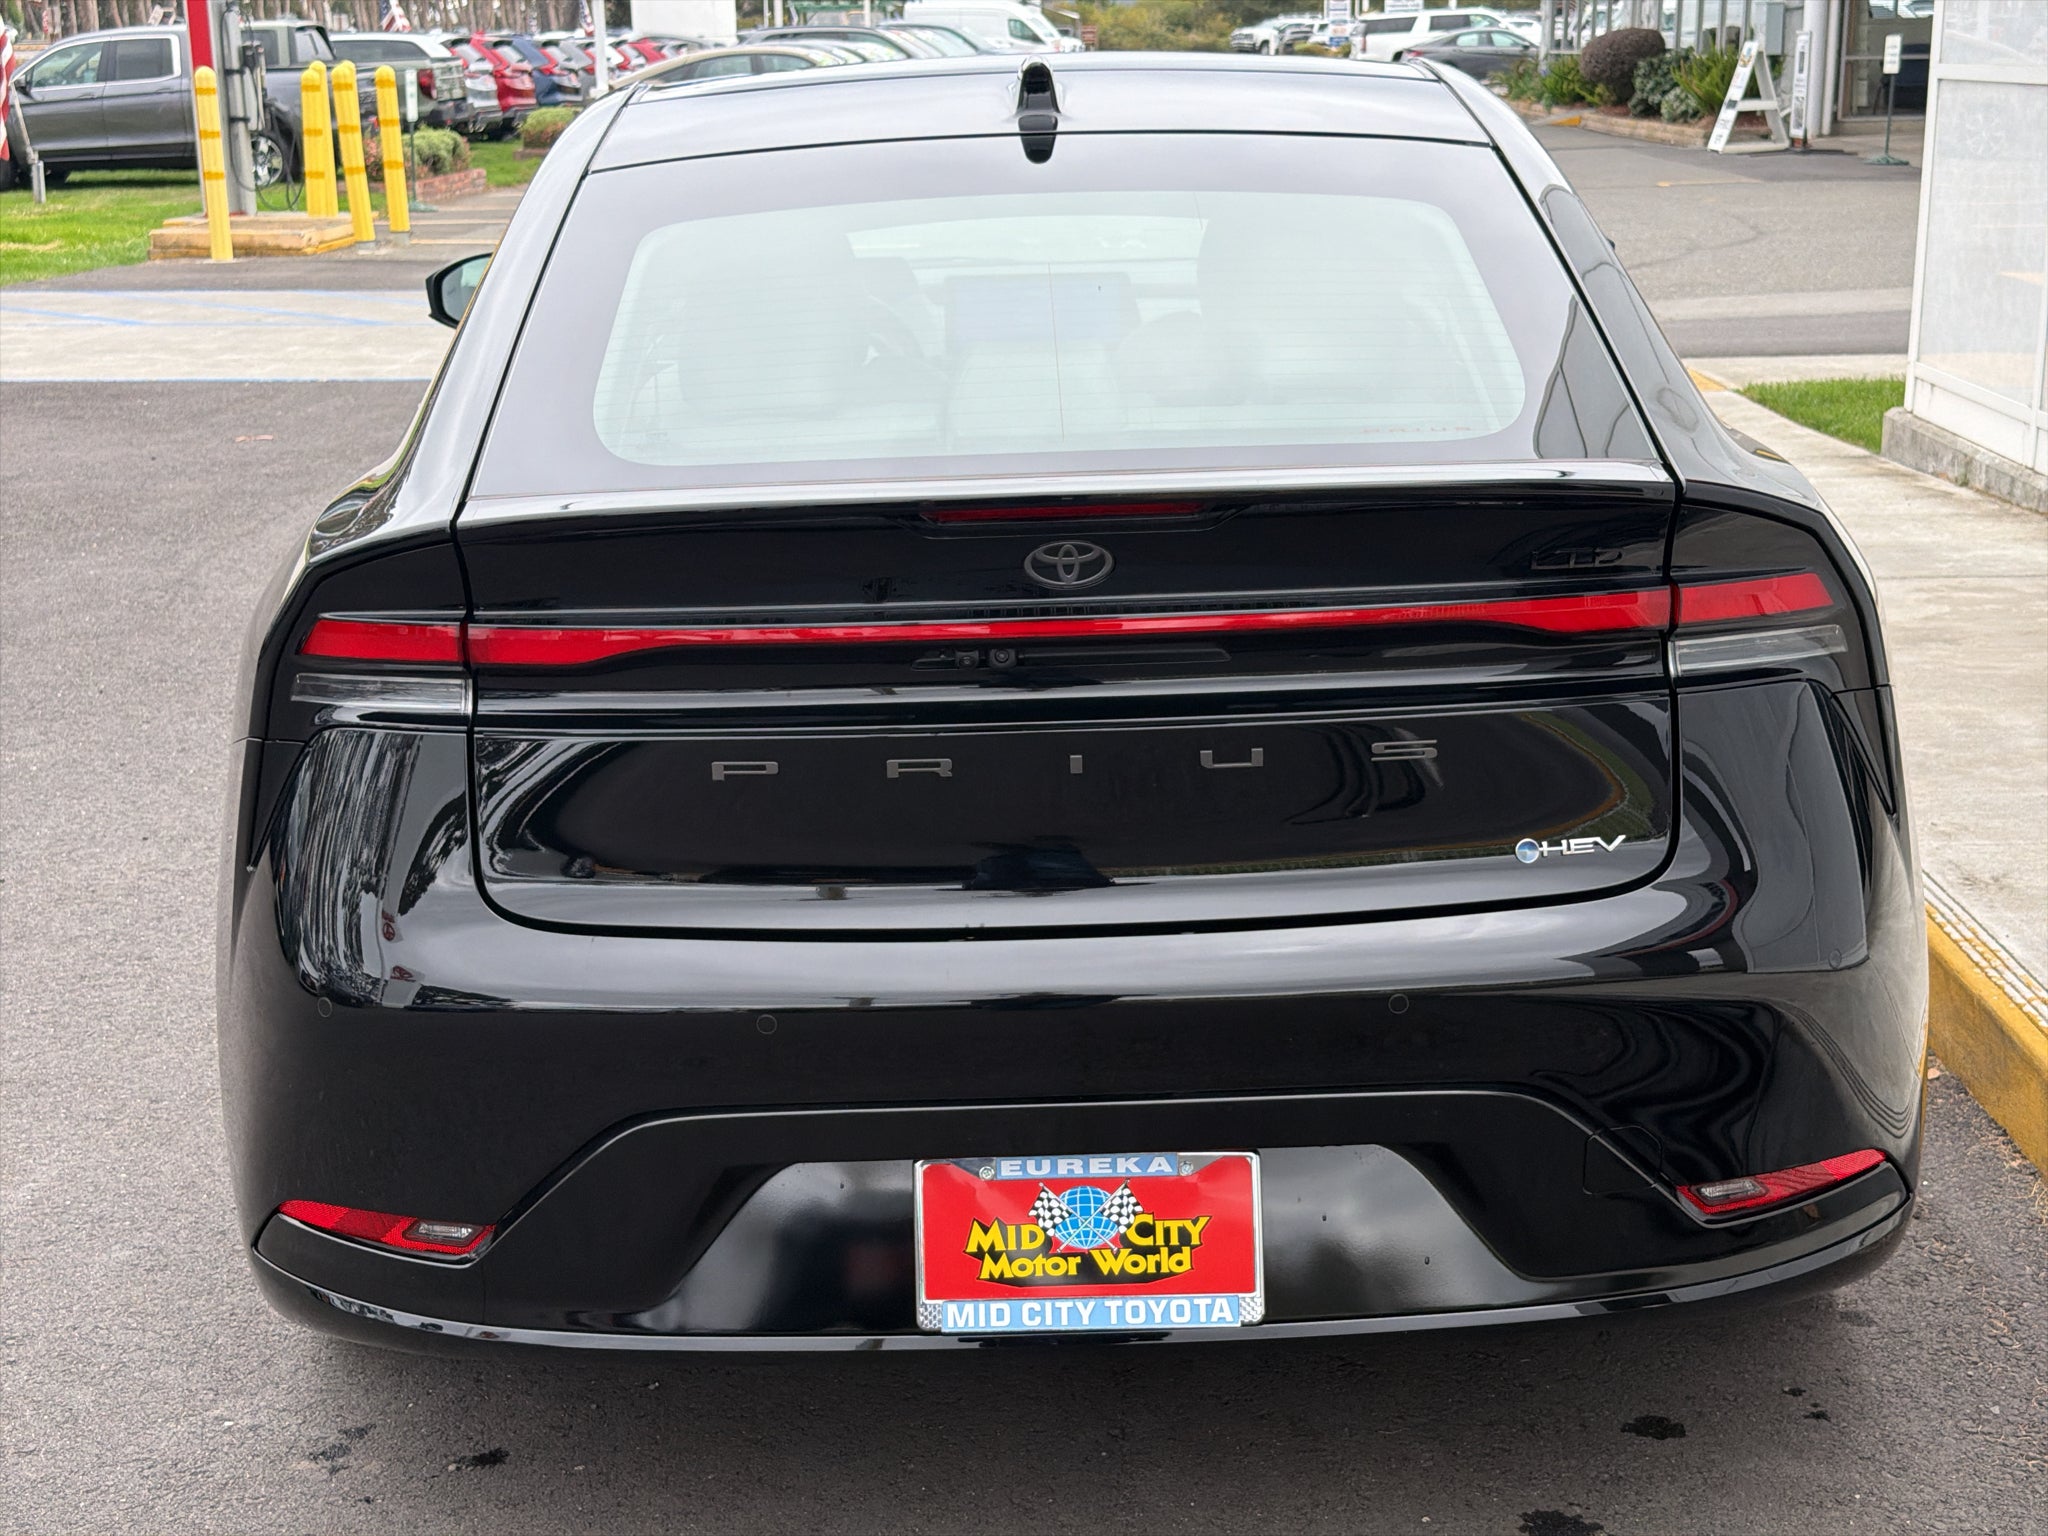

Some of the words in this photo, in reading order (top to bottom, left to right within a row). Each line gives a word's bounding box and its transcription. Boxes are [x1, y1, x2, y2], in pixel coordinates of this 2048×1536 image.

[711, 739, 1438, 781] PRIUS
[1541, 834, 1627, 857] HEV
[1000, 1157, 1173, 1176] EUREKA
[980, 1252, 1081, 1279] Motor
[1091, 1248, 1192, 1275] World
[947, 1302, 1010, 1328] MID
[1021, 1302, 1097, 1327] CITY
[1106, 1297, 1234, 1324] TOYOTA
